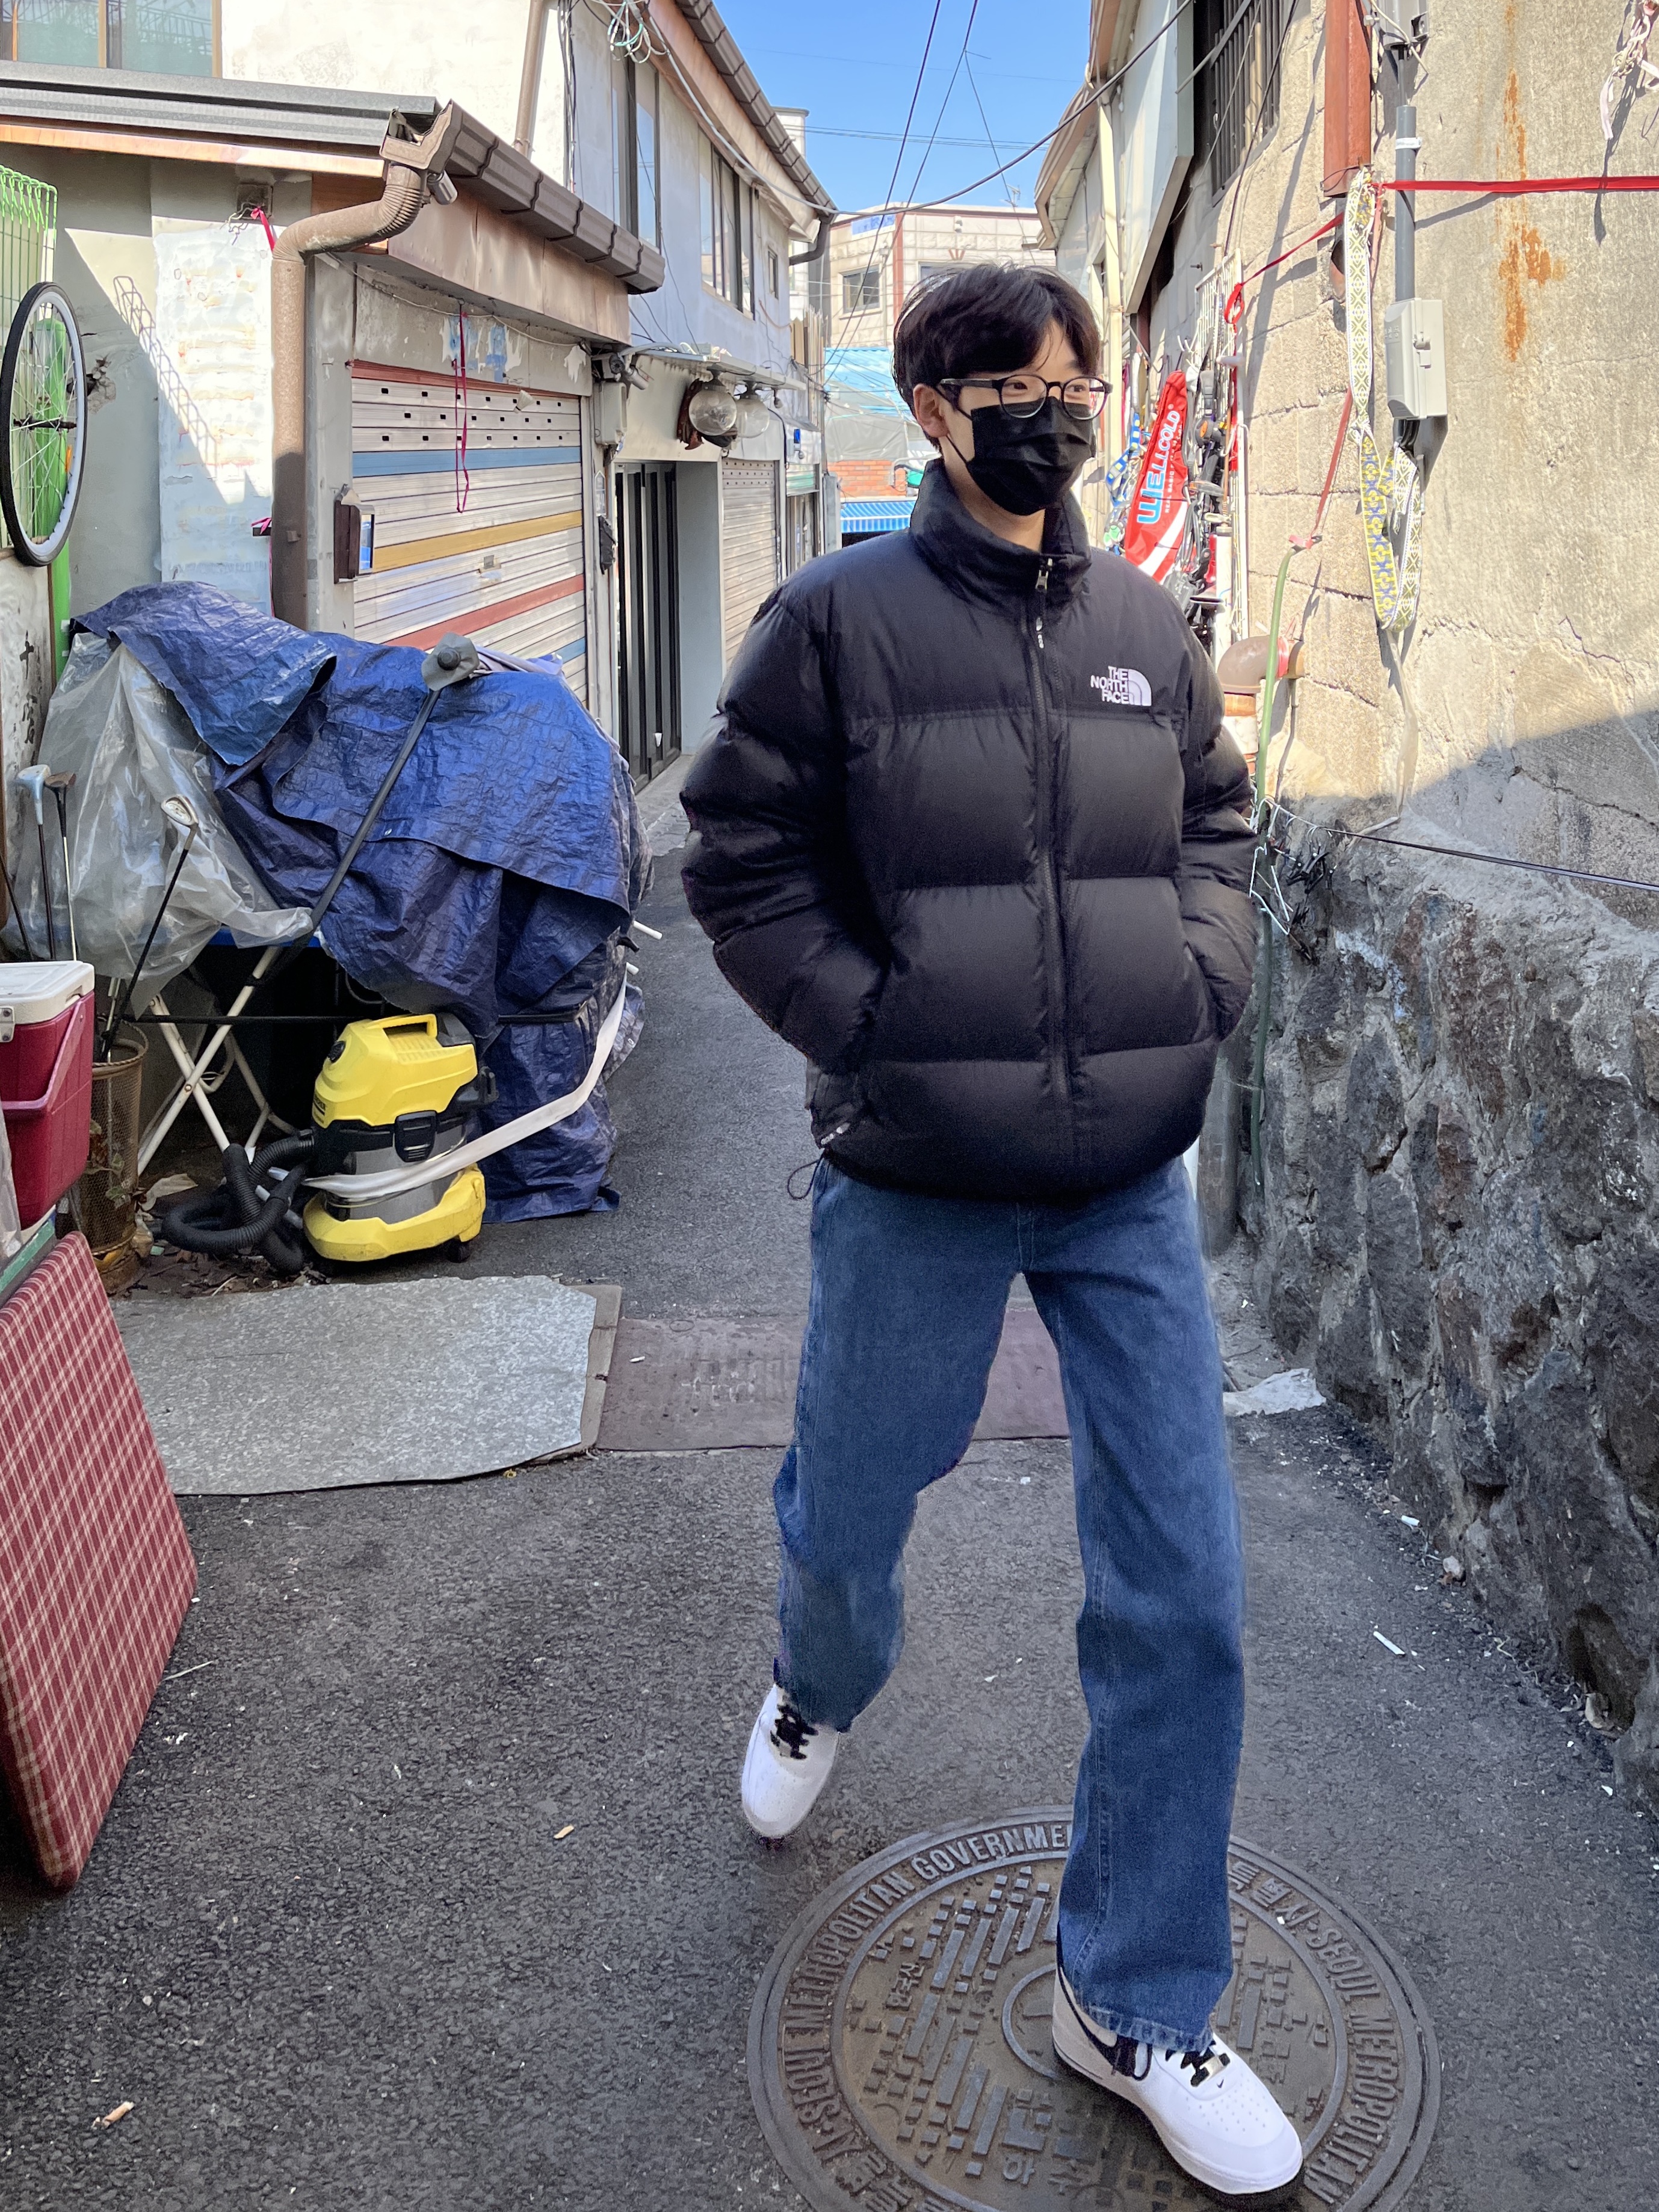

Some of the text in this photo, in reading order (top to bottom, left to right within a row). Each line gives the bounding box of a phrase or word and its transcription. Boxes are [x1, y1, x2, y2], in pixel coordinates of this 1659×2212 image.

[1137, 410, 1180, 524] WELLCOLD
[1090, 675, 1128, 692] NORTH
[1102, 690, 1129, 704] FACE
[1108, 665, 1128, 680] THE
[784, 1871, 916, 2030] METROPOLITAN
[1306, 1929, 1380, 2002] SEOUL
[784, 2045, 841, 2122] SEOUL
[1304, 2011, 1398, 2204] METROPOLITAN
